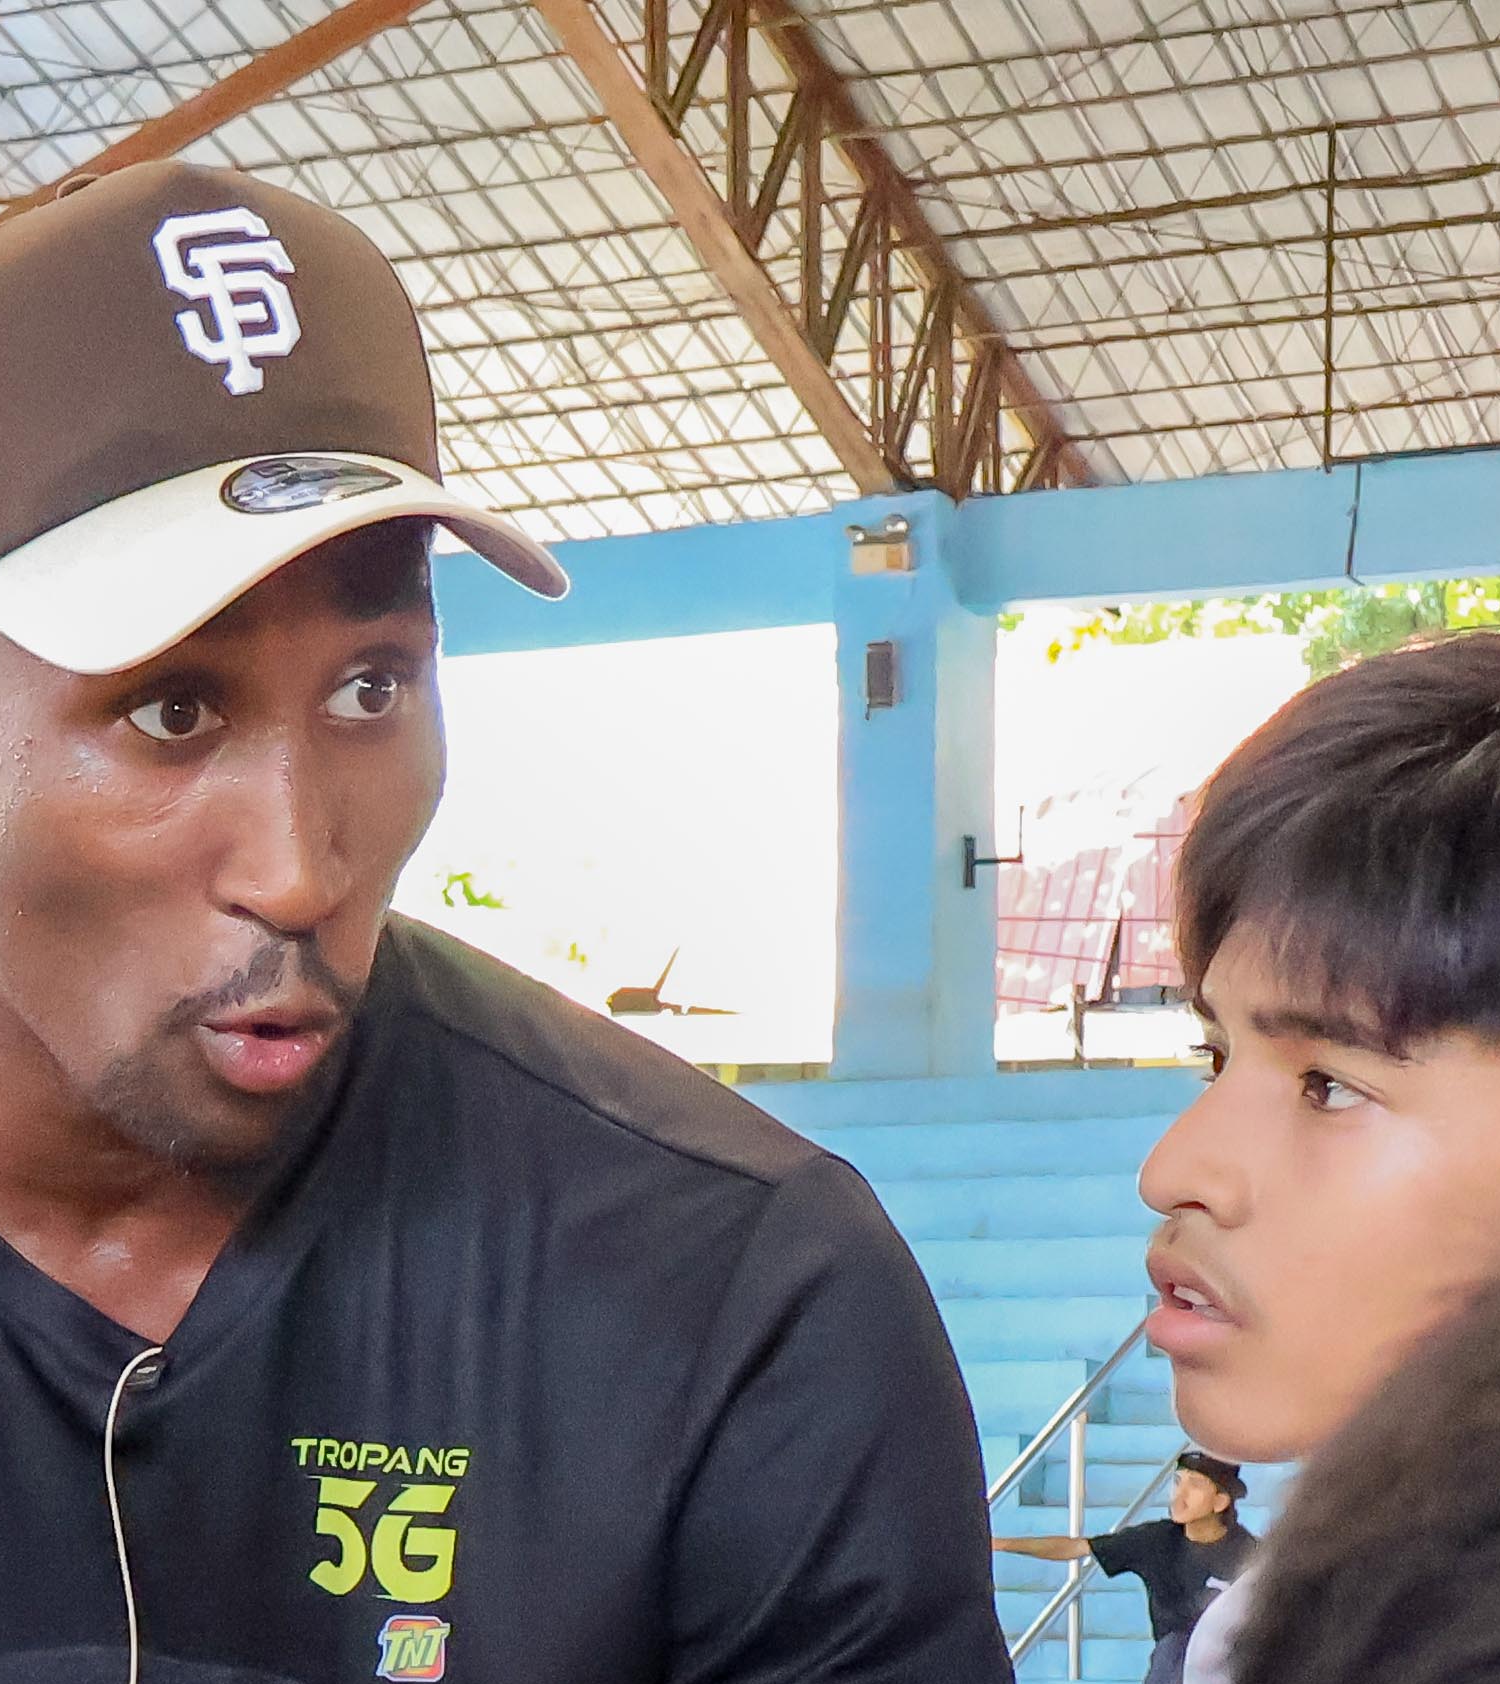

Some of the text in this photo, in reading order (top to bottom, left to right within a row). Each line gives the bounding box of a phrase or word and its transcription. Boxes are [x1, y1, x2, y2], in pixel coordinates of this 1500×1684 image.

[291, 1438, 470, 1477] TROPANG
[308, 1475, 456, 1604] 5G
[383, 1626, 450, 1672] TNT
